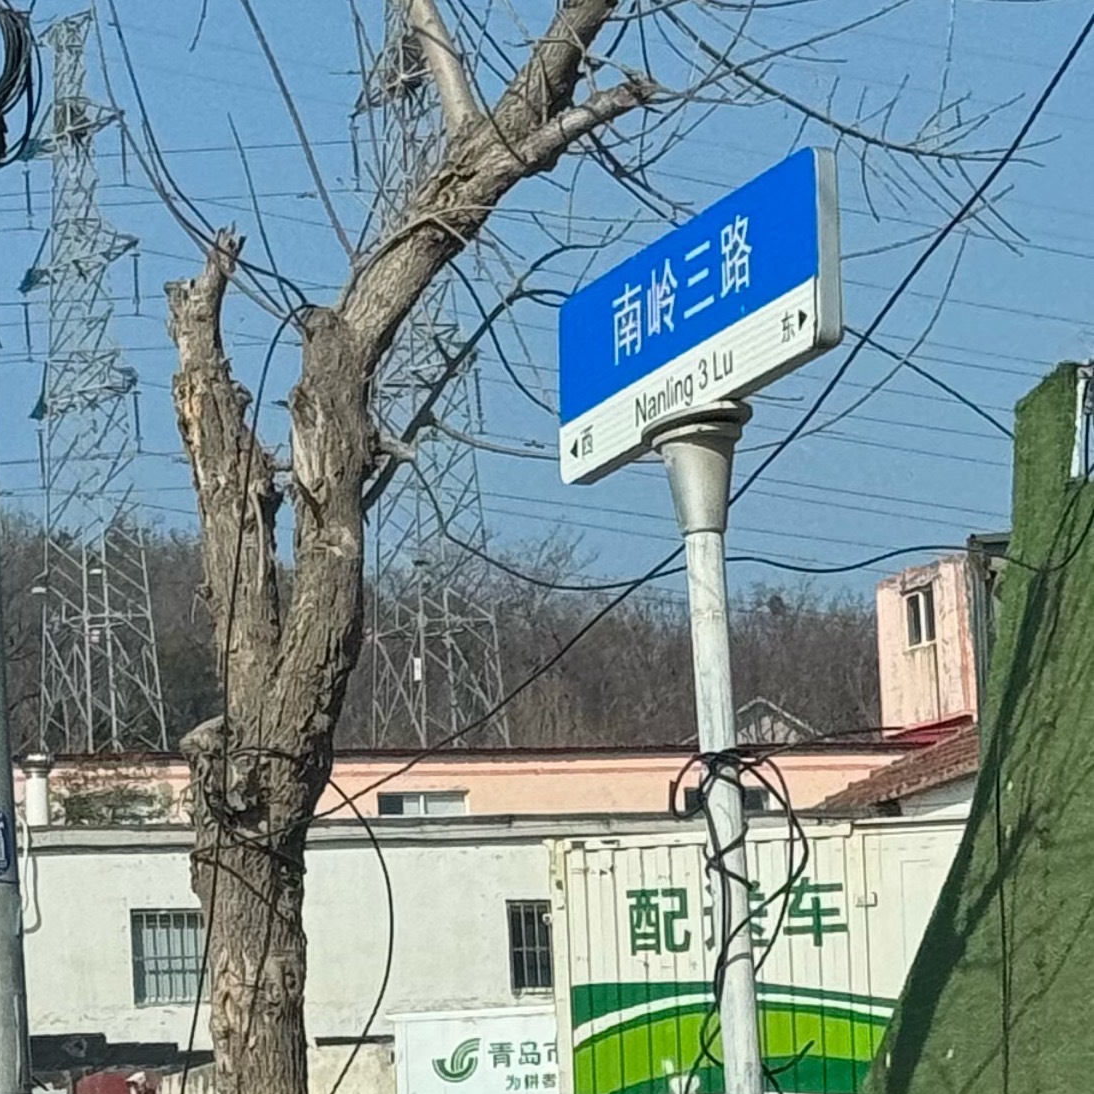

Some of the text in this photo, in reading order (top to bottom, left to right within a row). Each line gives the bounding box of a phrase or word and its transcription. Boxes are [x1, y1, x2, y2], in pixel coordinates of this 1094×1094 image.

[612, 214, 753, 366] 南岭三路
[781, 311, 796, 344] 东
[635, 350, 734, 428] Nanling 3 Lu
[580, 425, 594, 455] 西
